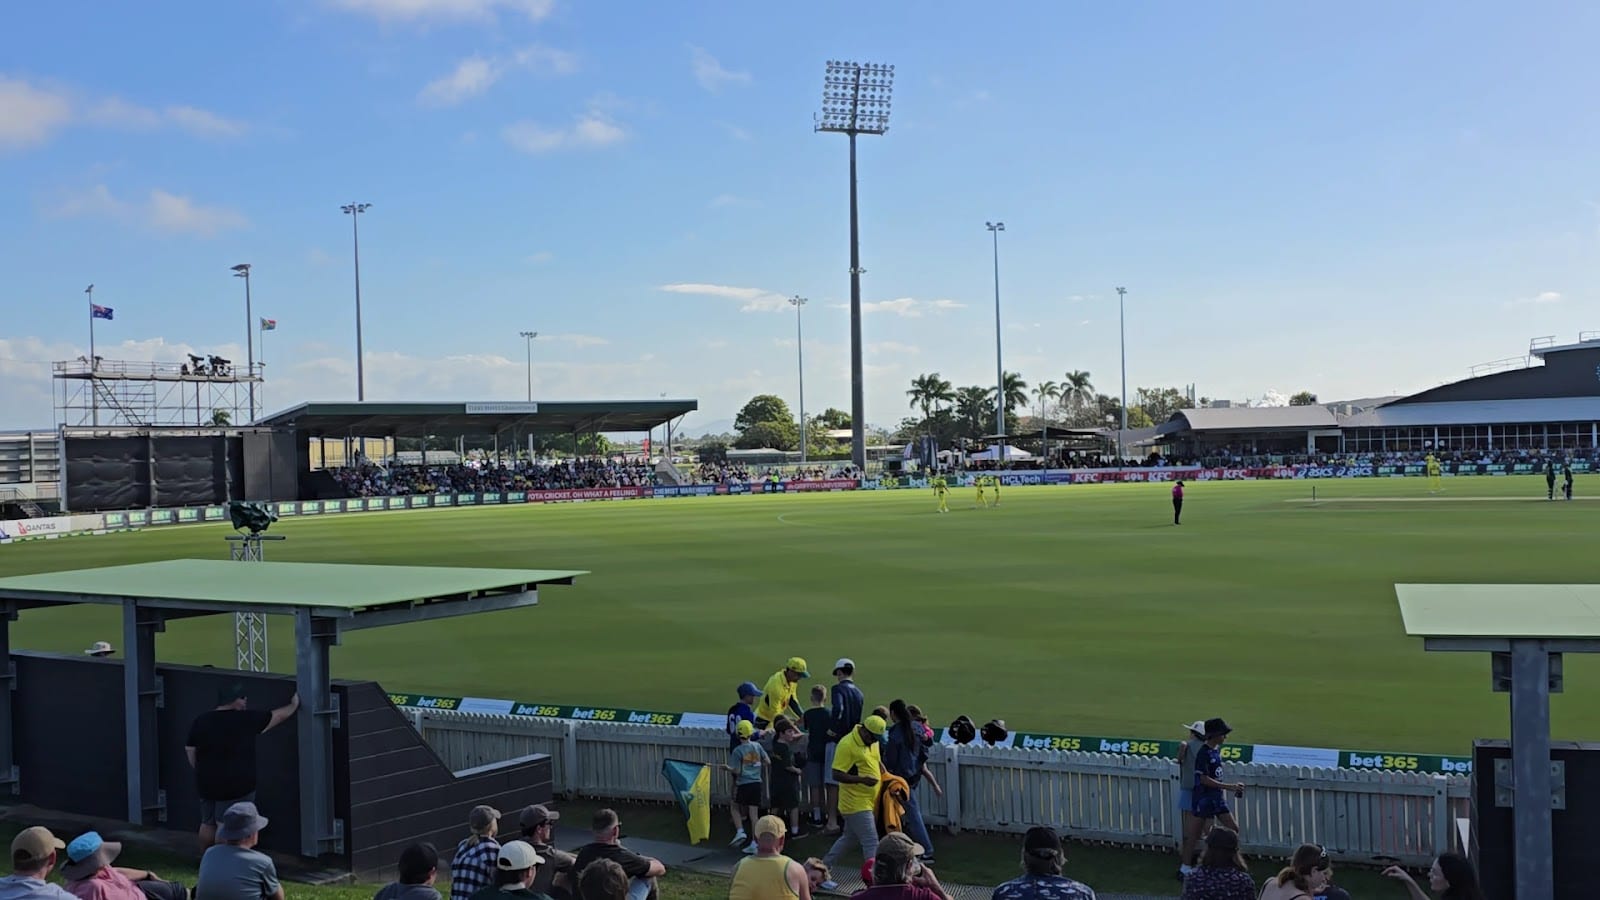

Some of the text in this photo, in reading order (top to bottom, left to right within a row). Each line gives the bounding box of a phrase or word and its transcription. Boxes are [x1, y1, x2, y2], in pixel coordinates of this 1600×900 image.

[1075, 473, 1098, 482] KFC
[1148, 472, 1172, 480] KFC
[1223, 469, 1247, 478] KFC
[862, 478, 899, 487] bet365
[1002, 475, 1040, 484] HCLTech
[609, 489, 638, 497] FEELING!
[26, 523, 56, 531] QANTAS
[416, 697, 456, 708] bet365
[516, 705, 560, 716] bet365
[572, 708, 616, 720] bet365
[628, 711, 673, 724] bet365
[1023, 735, 1081, 749] bet365
[1100, 739, 1161, 755] bet365
[1350, 753, 1418, 769] bet365
